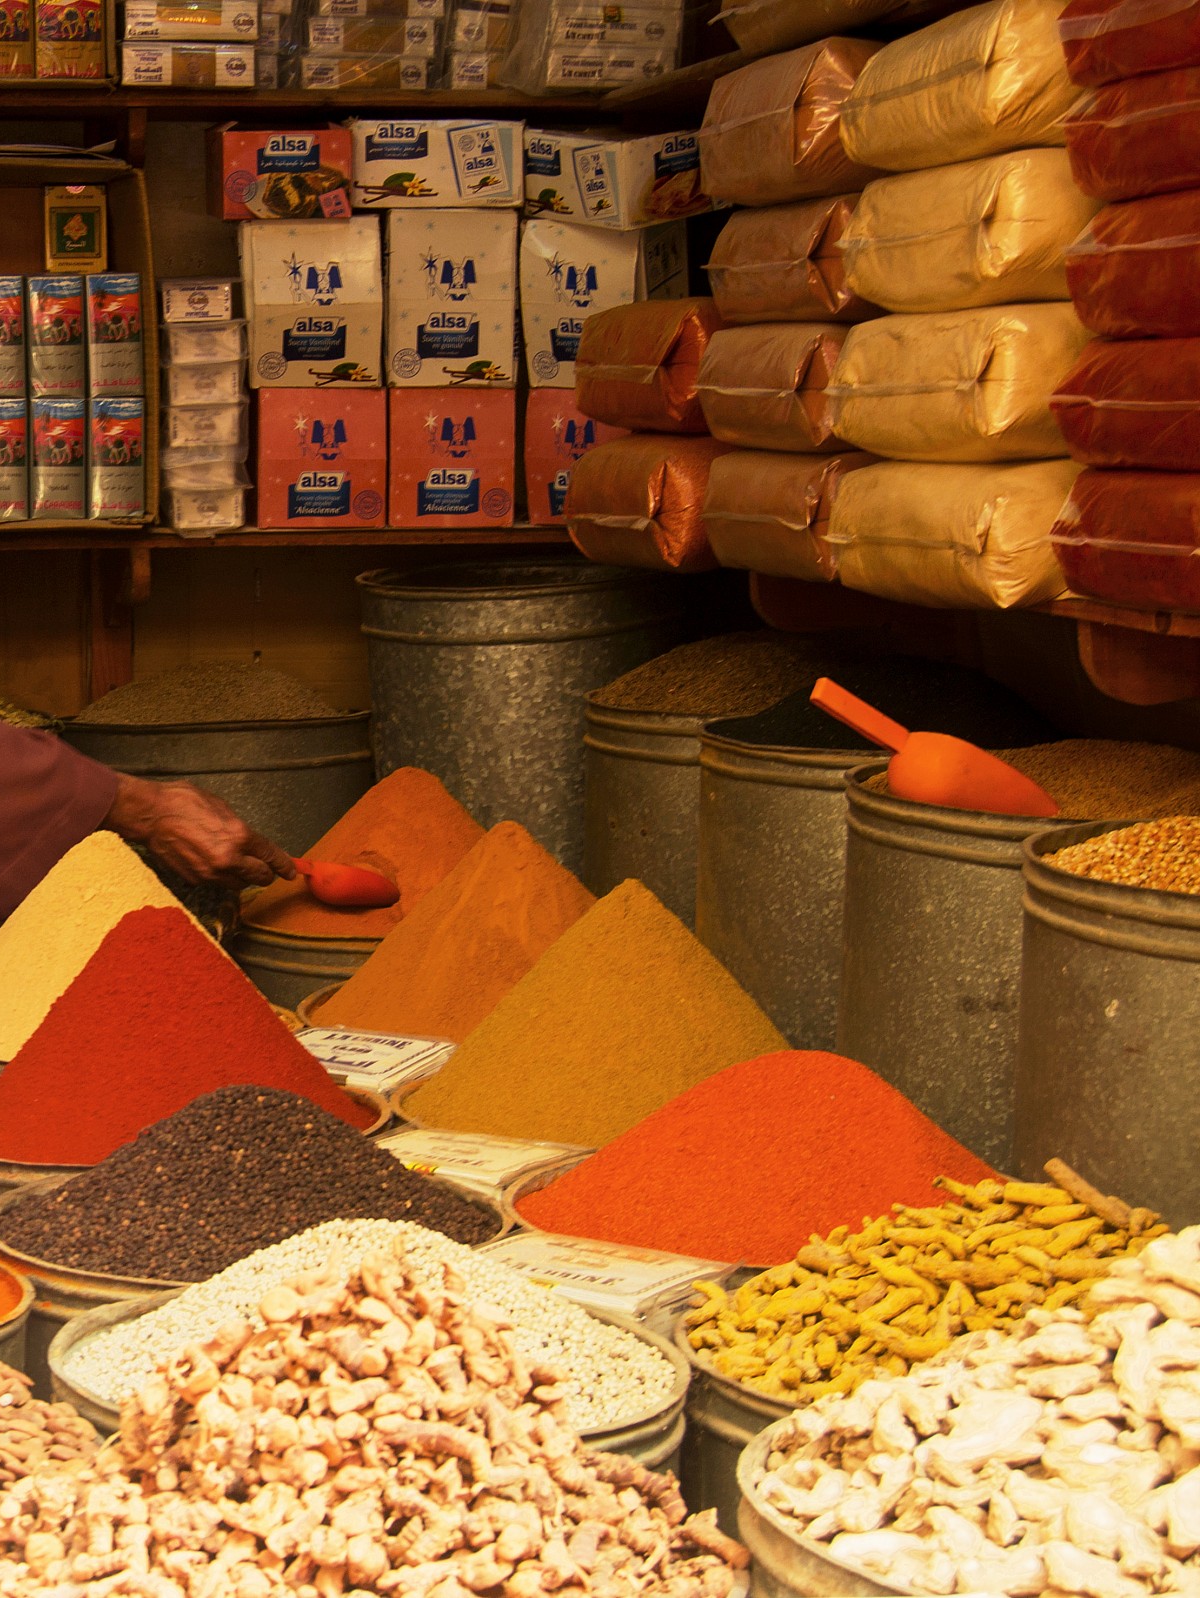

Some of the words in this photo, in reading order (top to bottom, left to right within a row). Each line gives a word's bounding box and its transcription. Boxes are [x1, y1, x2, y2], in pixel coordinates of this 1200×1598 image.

[378, 123, 416, 139] alsa
[269, 135, 308, 152] alsa
[530, 138, 552, 155] alsa
[664, 136, 696, 153] alsa
[466, 156, 494, 171] alsa
[585, 178, 605, 193] alsa
[296, 317, 333, 333] alsa
[429, 312, 467, 329] alsa
[560, 318, 584, 334] als
[301, 472, 338, 488] alsa
[430, 470, 467, 485] alsa
